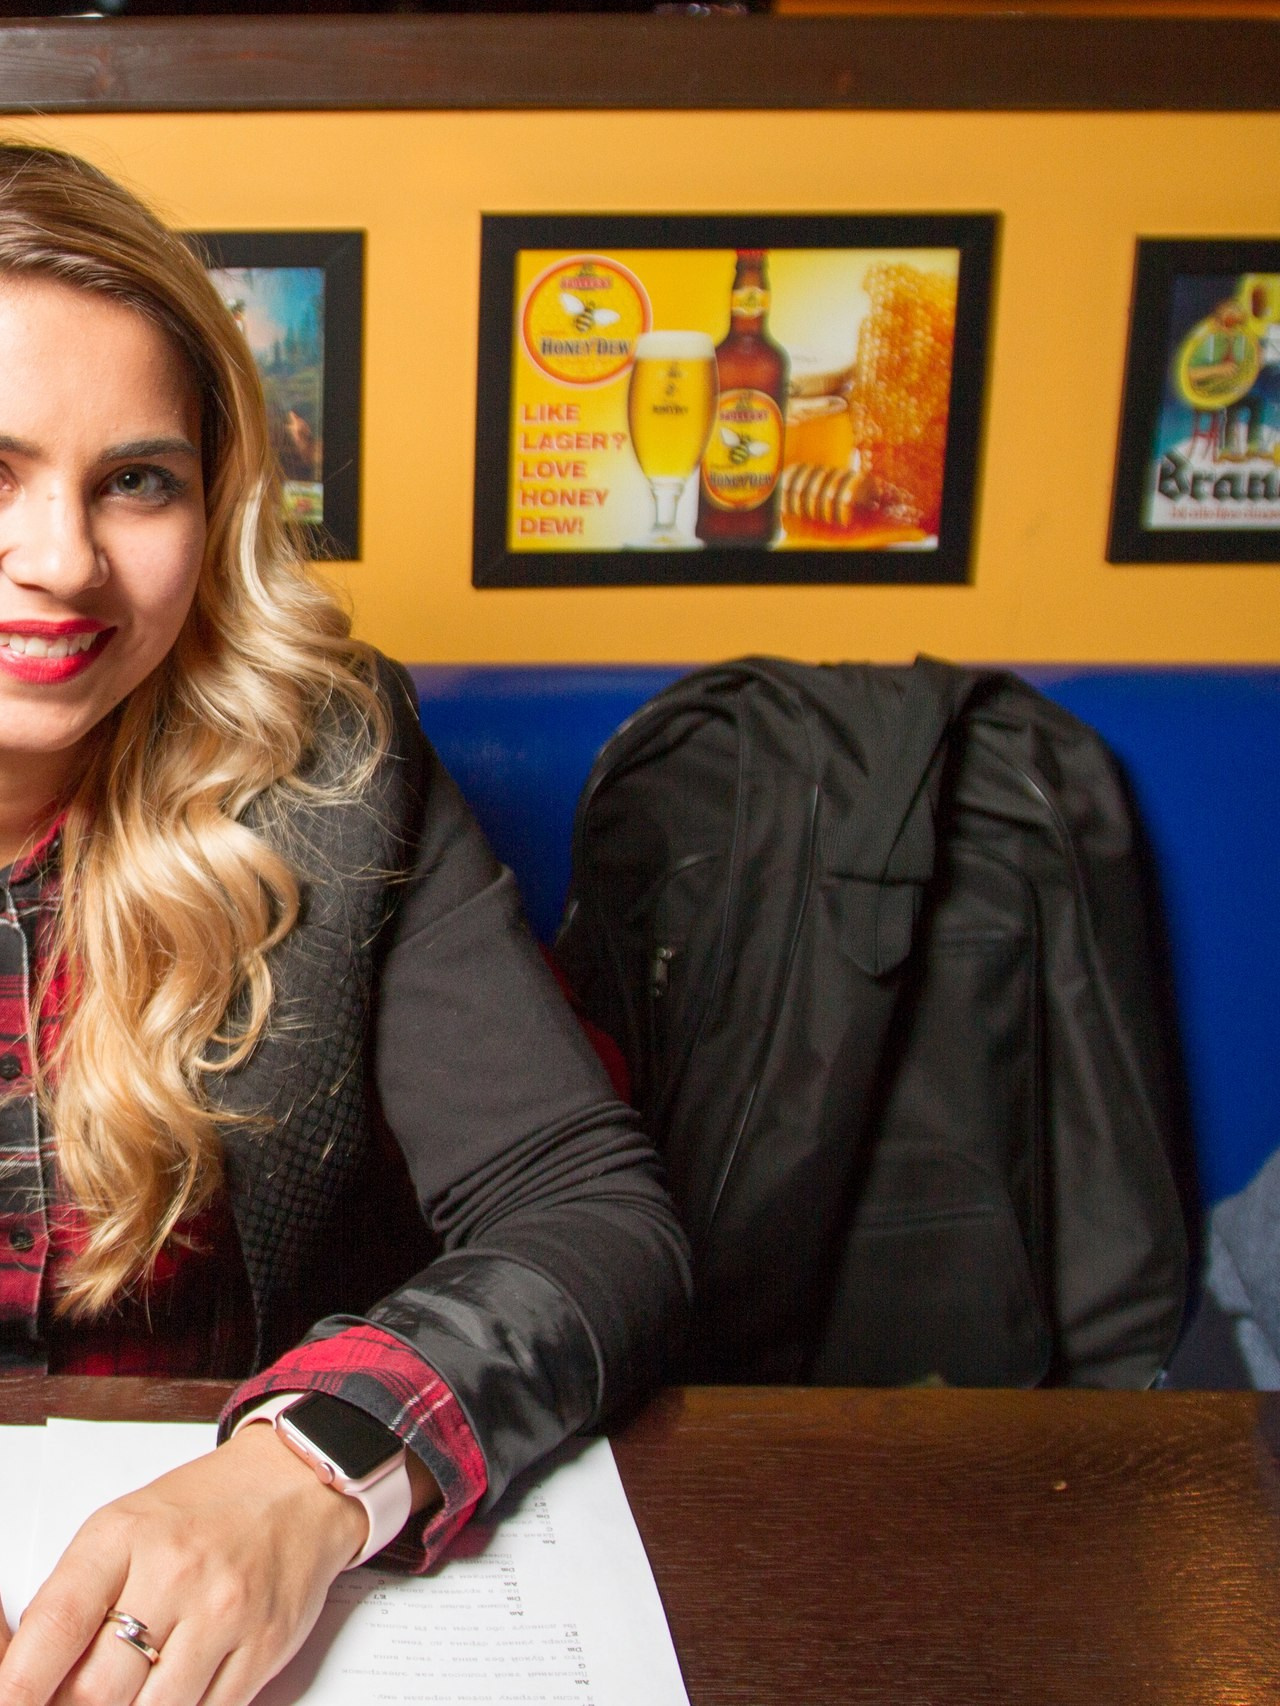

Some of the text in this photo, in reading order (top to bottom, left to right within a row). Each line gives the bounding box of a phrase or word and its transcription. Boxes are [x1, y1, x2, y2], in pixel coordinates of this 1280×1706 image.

[521, 404, 580, 425] LIKE
[520, 431, 628, 452] LAGER?
[519, 461, 587, 480] LOVE
[1158, 450, 1280, 501] Bran
[519, 488, 609, 508] HONEY
[518, 516, 584, 536] DEW!
